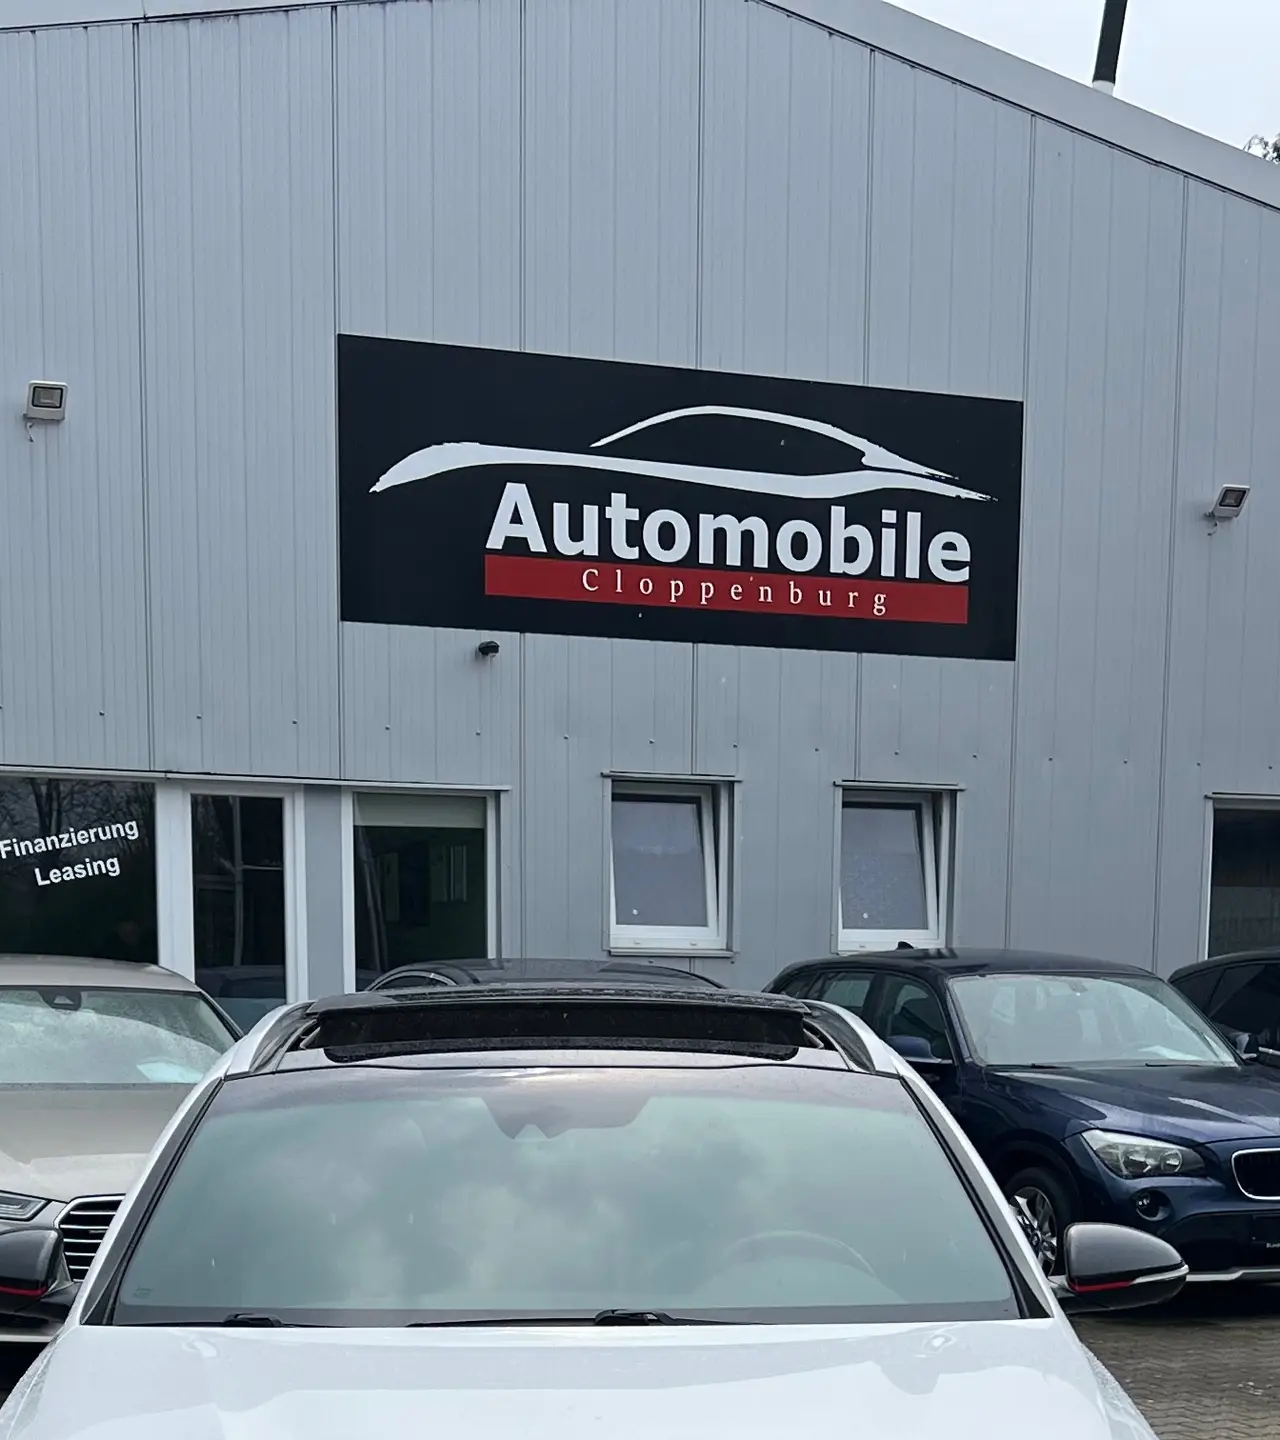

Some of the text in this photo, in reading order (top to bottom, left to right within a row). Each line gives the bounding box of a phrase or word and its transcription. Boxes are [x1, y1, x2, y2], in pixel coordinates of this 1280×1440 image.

[486, 482, 971, 583] Automobile
[581, 568, 888, 615] Cloppenburg
[34, 857, 121, 886] Leasing
